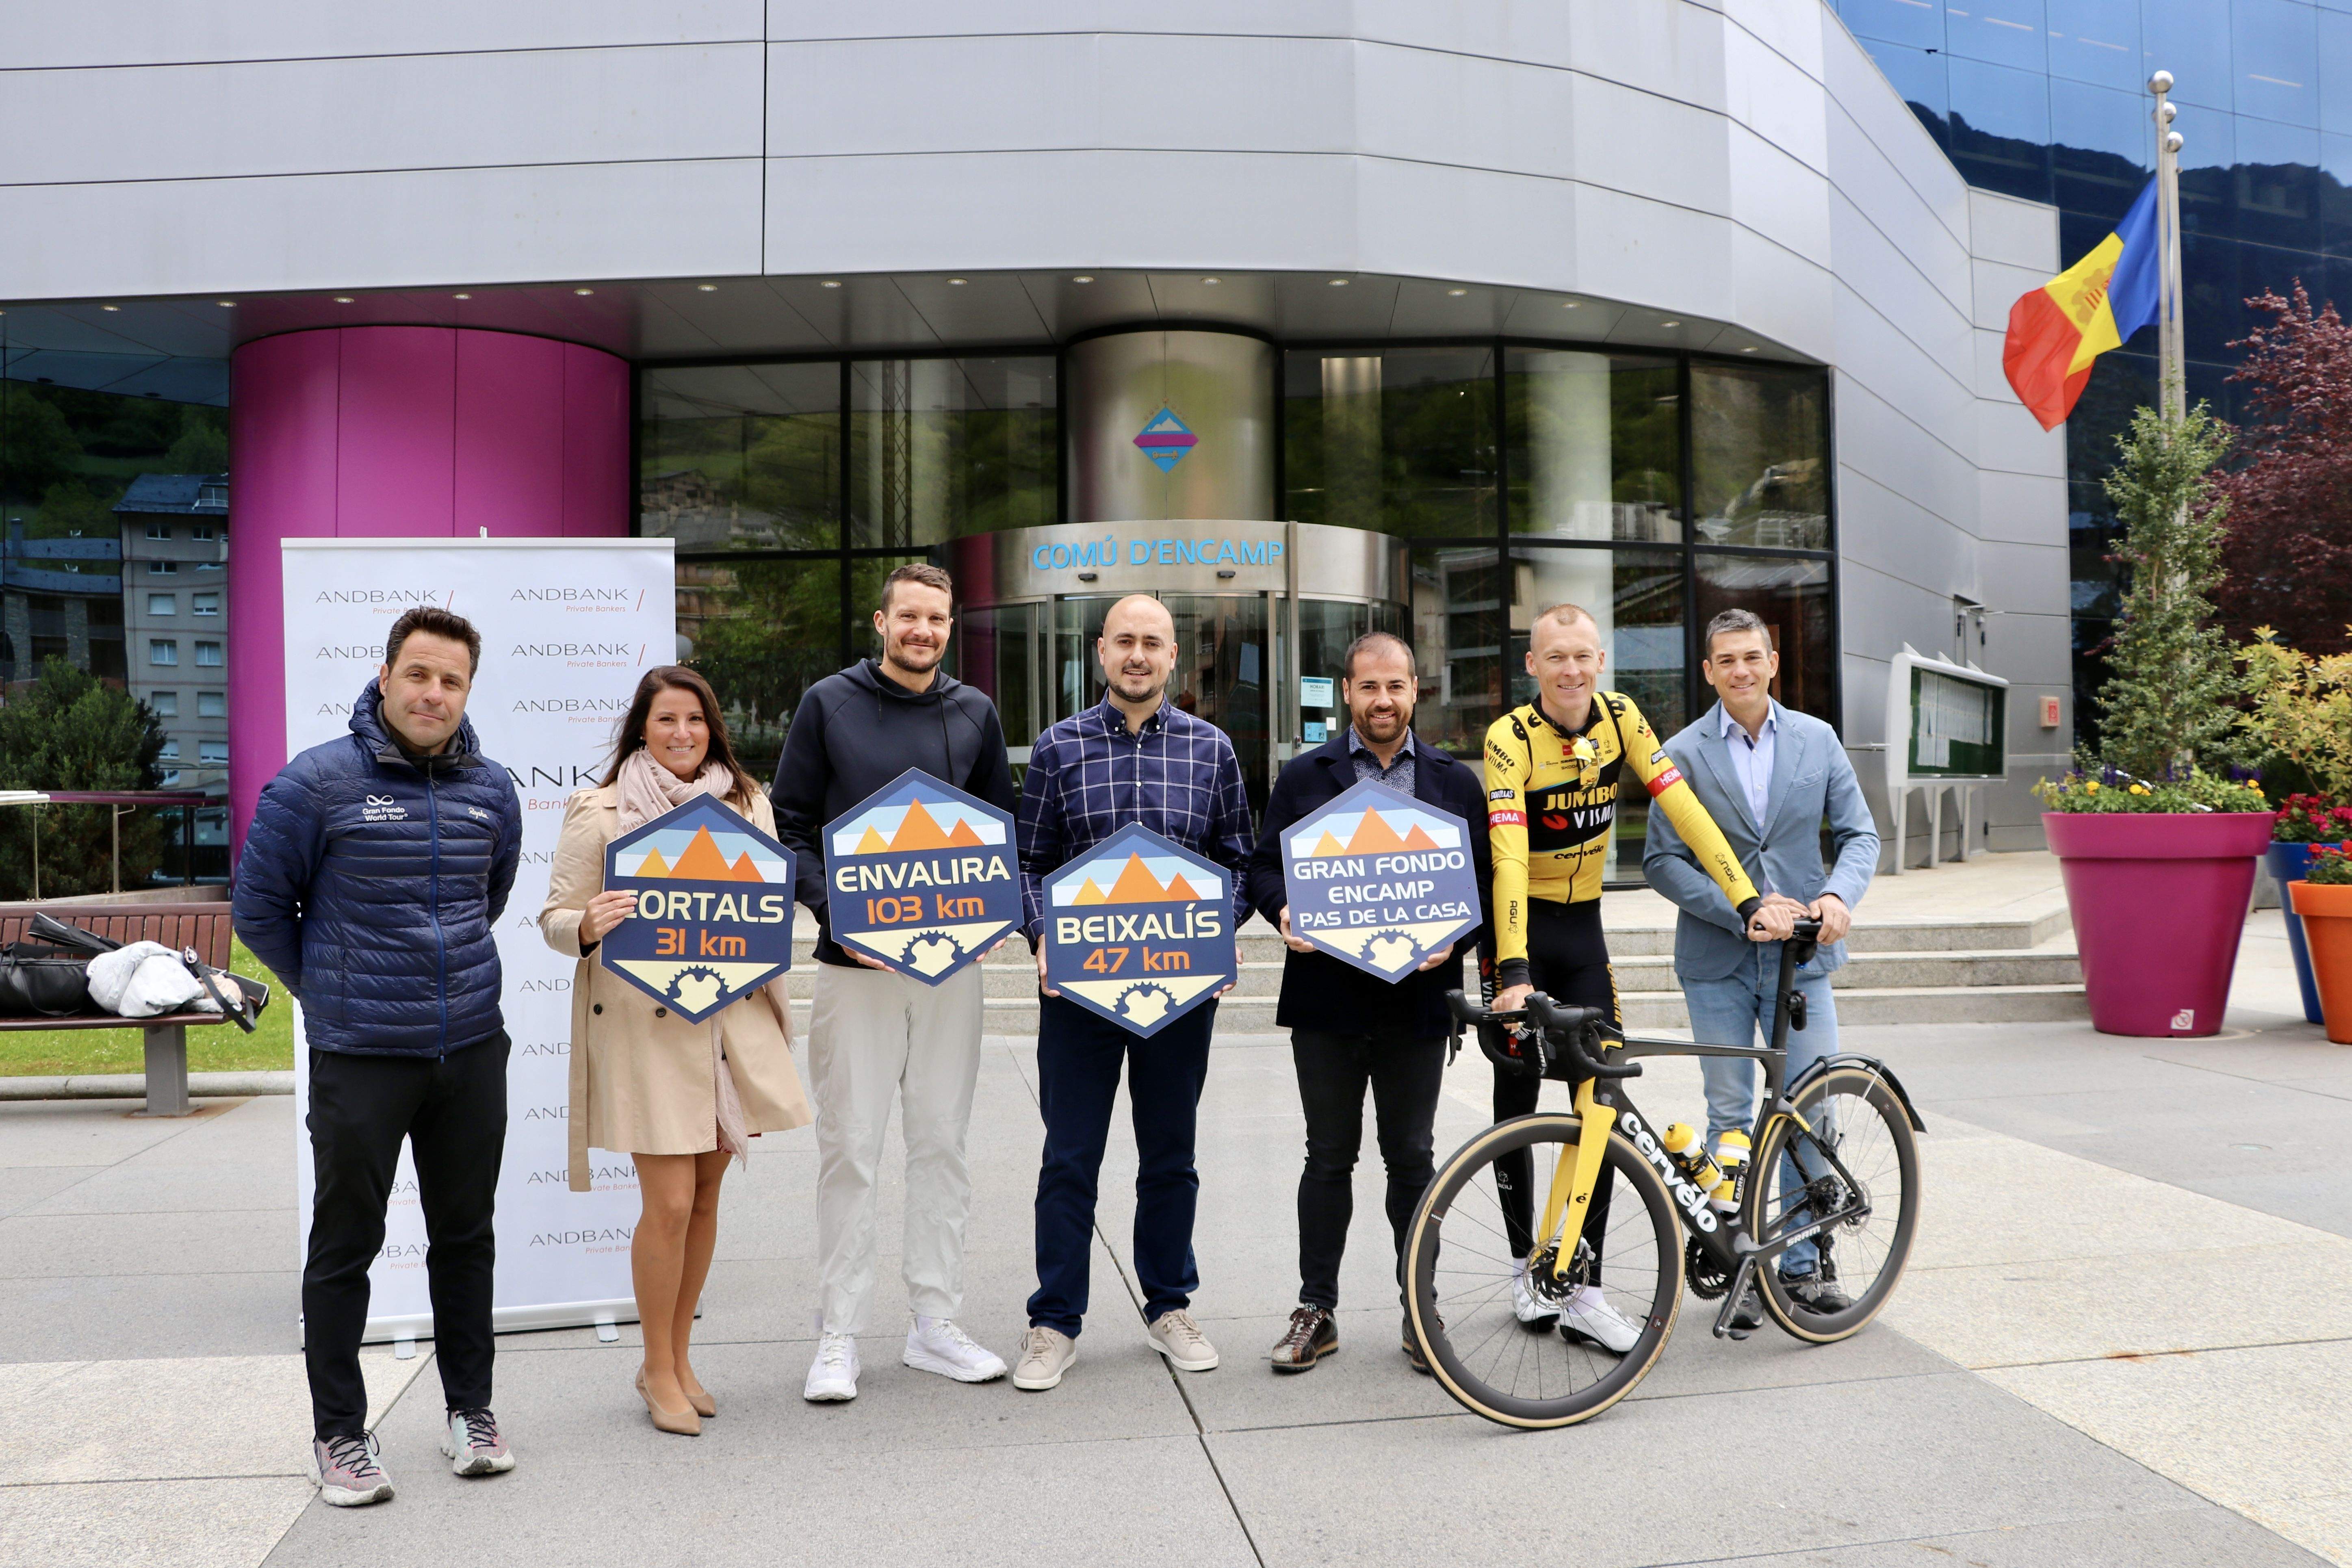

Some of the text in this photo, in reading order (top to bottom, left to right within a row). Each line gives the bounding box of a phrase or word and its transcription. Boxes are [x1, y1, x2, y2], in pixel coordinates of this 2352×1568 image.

[1032, 534, 1117, 570] COMÚ
[315, 590, 437, 603] ANDBANK
[510, 588, 629, 601] ANDBANK
[316, 646, 384, 659] ANDB
[511, 643, 630, 657] ANDBANK
[1487, 739, 1515, 767] JUMBO
[1489, 753, 1508, 775] VISMA
[1490, 790, 1514, 800] GORILLAS
[1543, 782, 1618, 811] JUMBO
[468, 807, 489, 820] Rapha
[1490, 813, 1520, 825] HEMA
[835, 854, 1012, 894] ENVALIRA
[1293, 851, 1466, 881] GRAN FONDO
[1328, 880, 1435, 904] ENCAMP
[867, 894, 984, 925] 103 km
[1299, 901, 1472, 928] PAS DE LA CASA
[1056, 902, 1222, 945] BEIXALÍS
[656, 927, 746, 957] 31 km
[1082, 946, 1191, 974] 47 km
[529, 1228, 632, 1247] ANDBAN
[1786, 1225, 1821, 1247] SRAM
[390, 1262, 418, 1270] Private
